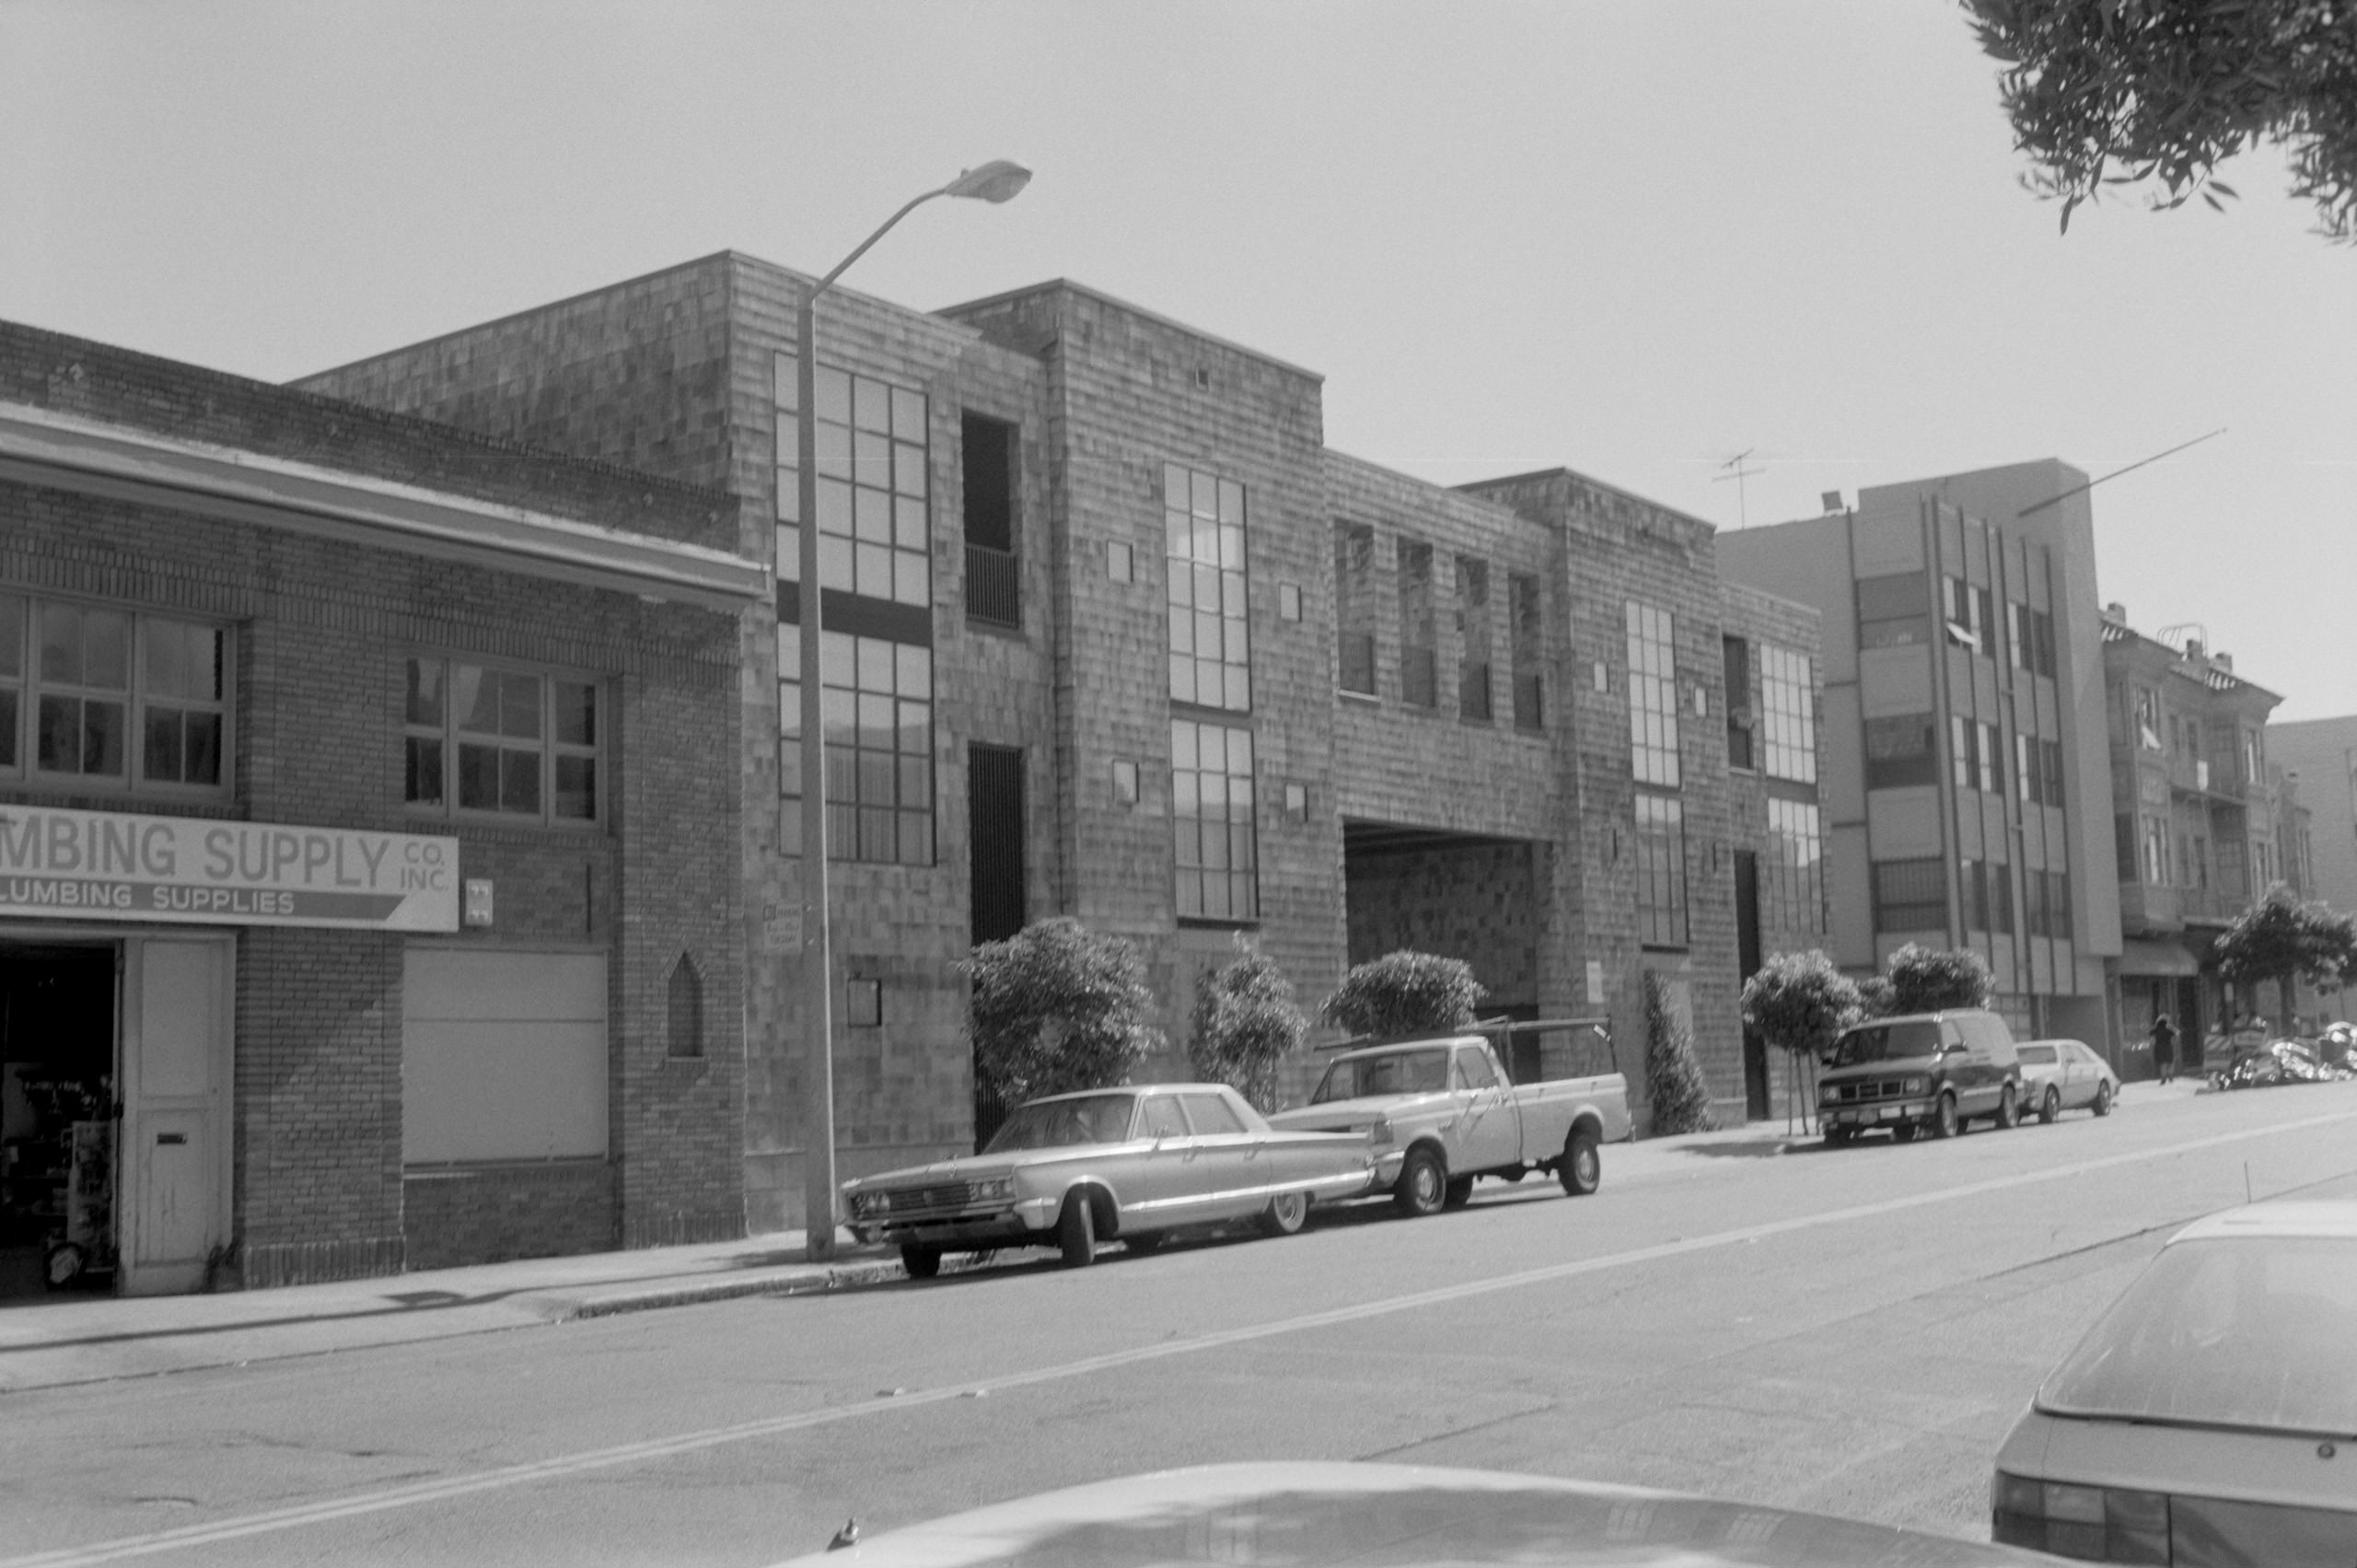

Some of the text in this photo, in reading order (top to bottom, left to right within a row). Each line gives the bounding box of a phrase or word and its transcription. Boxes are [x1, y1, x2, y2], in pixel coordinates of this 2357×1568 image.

[0, 815, 390, 889] MBING SUPPLY
[152, 885, 295, 914] SUPPLIES
